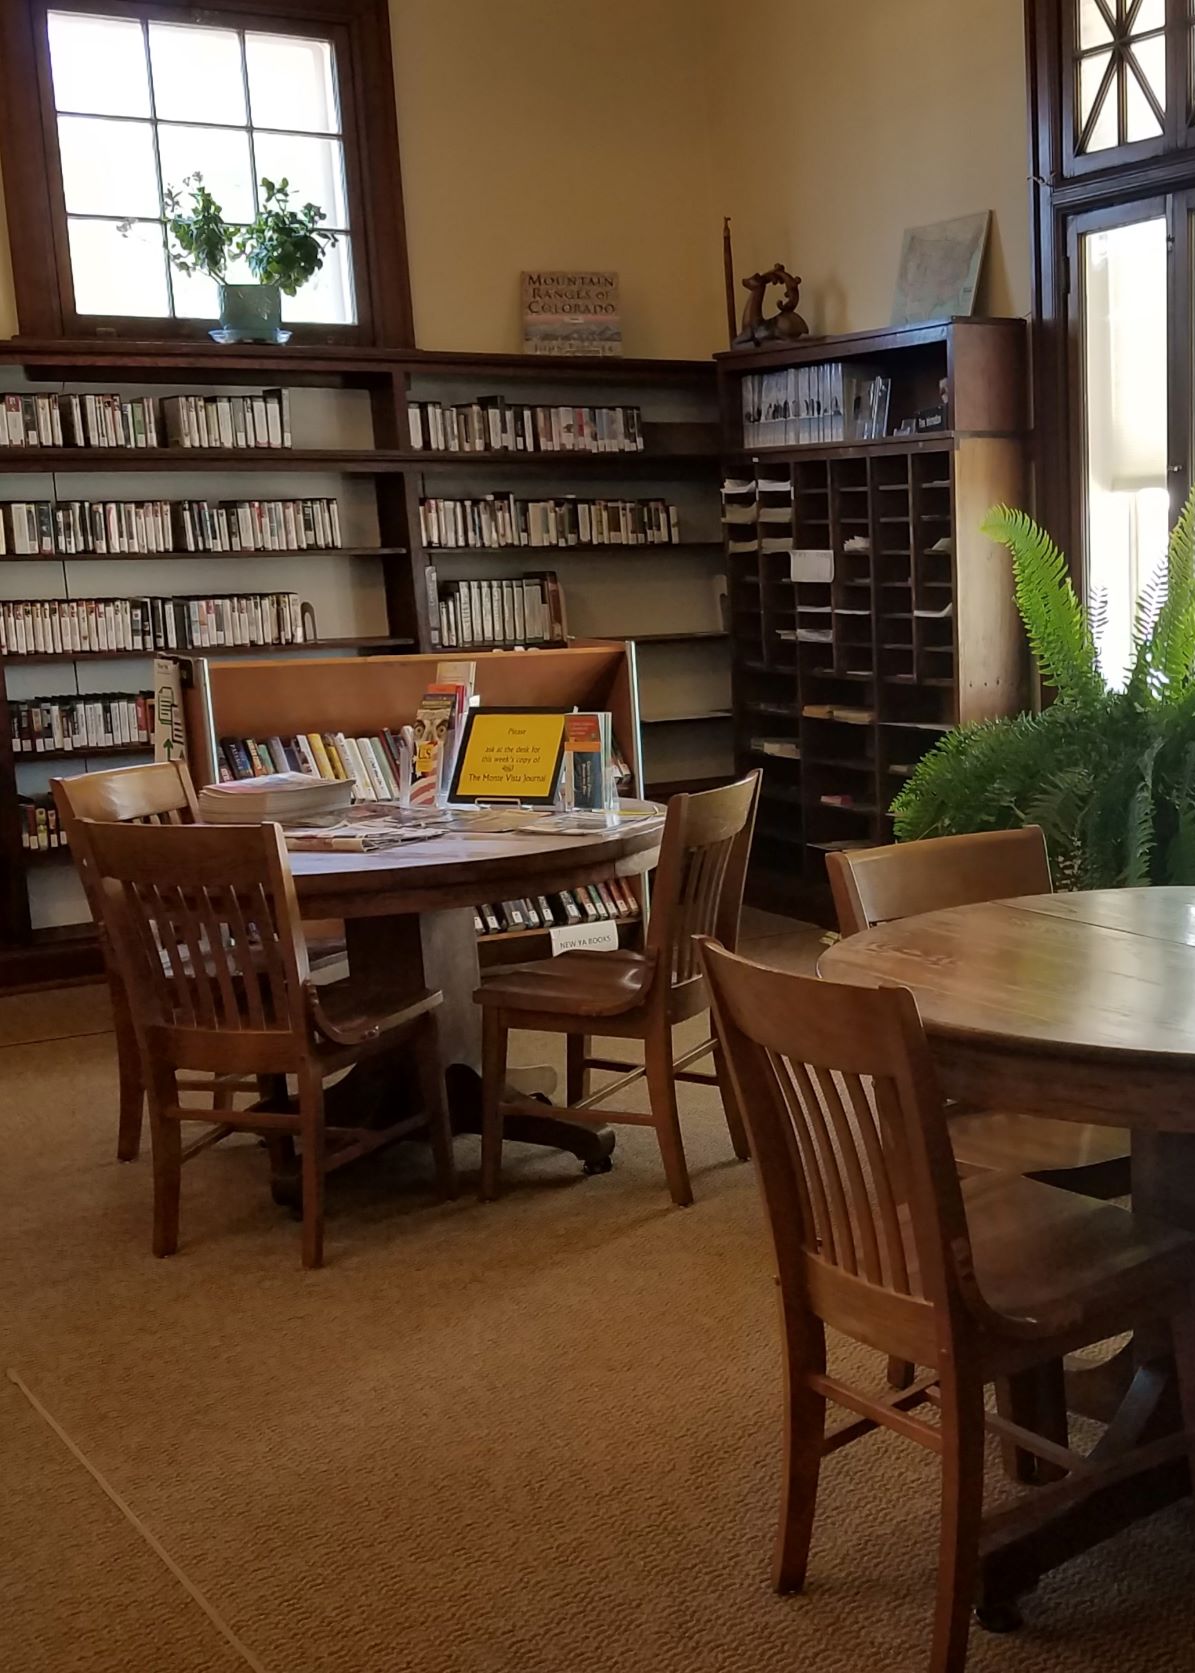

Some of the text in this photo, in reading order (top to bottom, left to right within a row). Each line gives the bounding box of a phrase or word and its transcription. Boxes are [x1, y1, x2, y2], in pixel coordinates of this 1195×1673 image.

[528, 274, 614, 287] MOUNTAIN
[532, 288, 590, 300] RANGES
[528, 301, 615, 314] COLORADO
[469, 773, 481, 781] The
[560, 940, 576, 949] NEW
[588, 935, 611, 945] BOOKS
